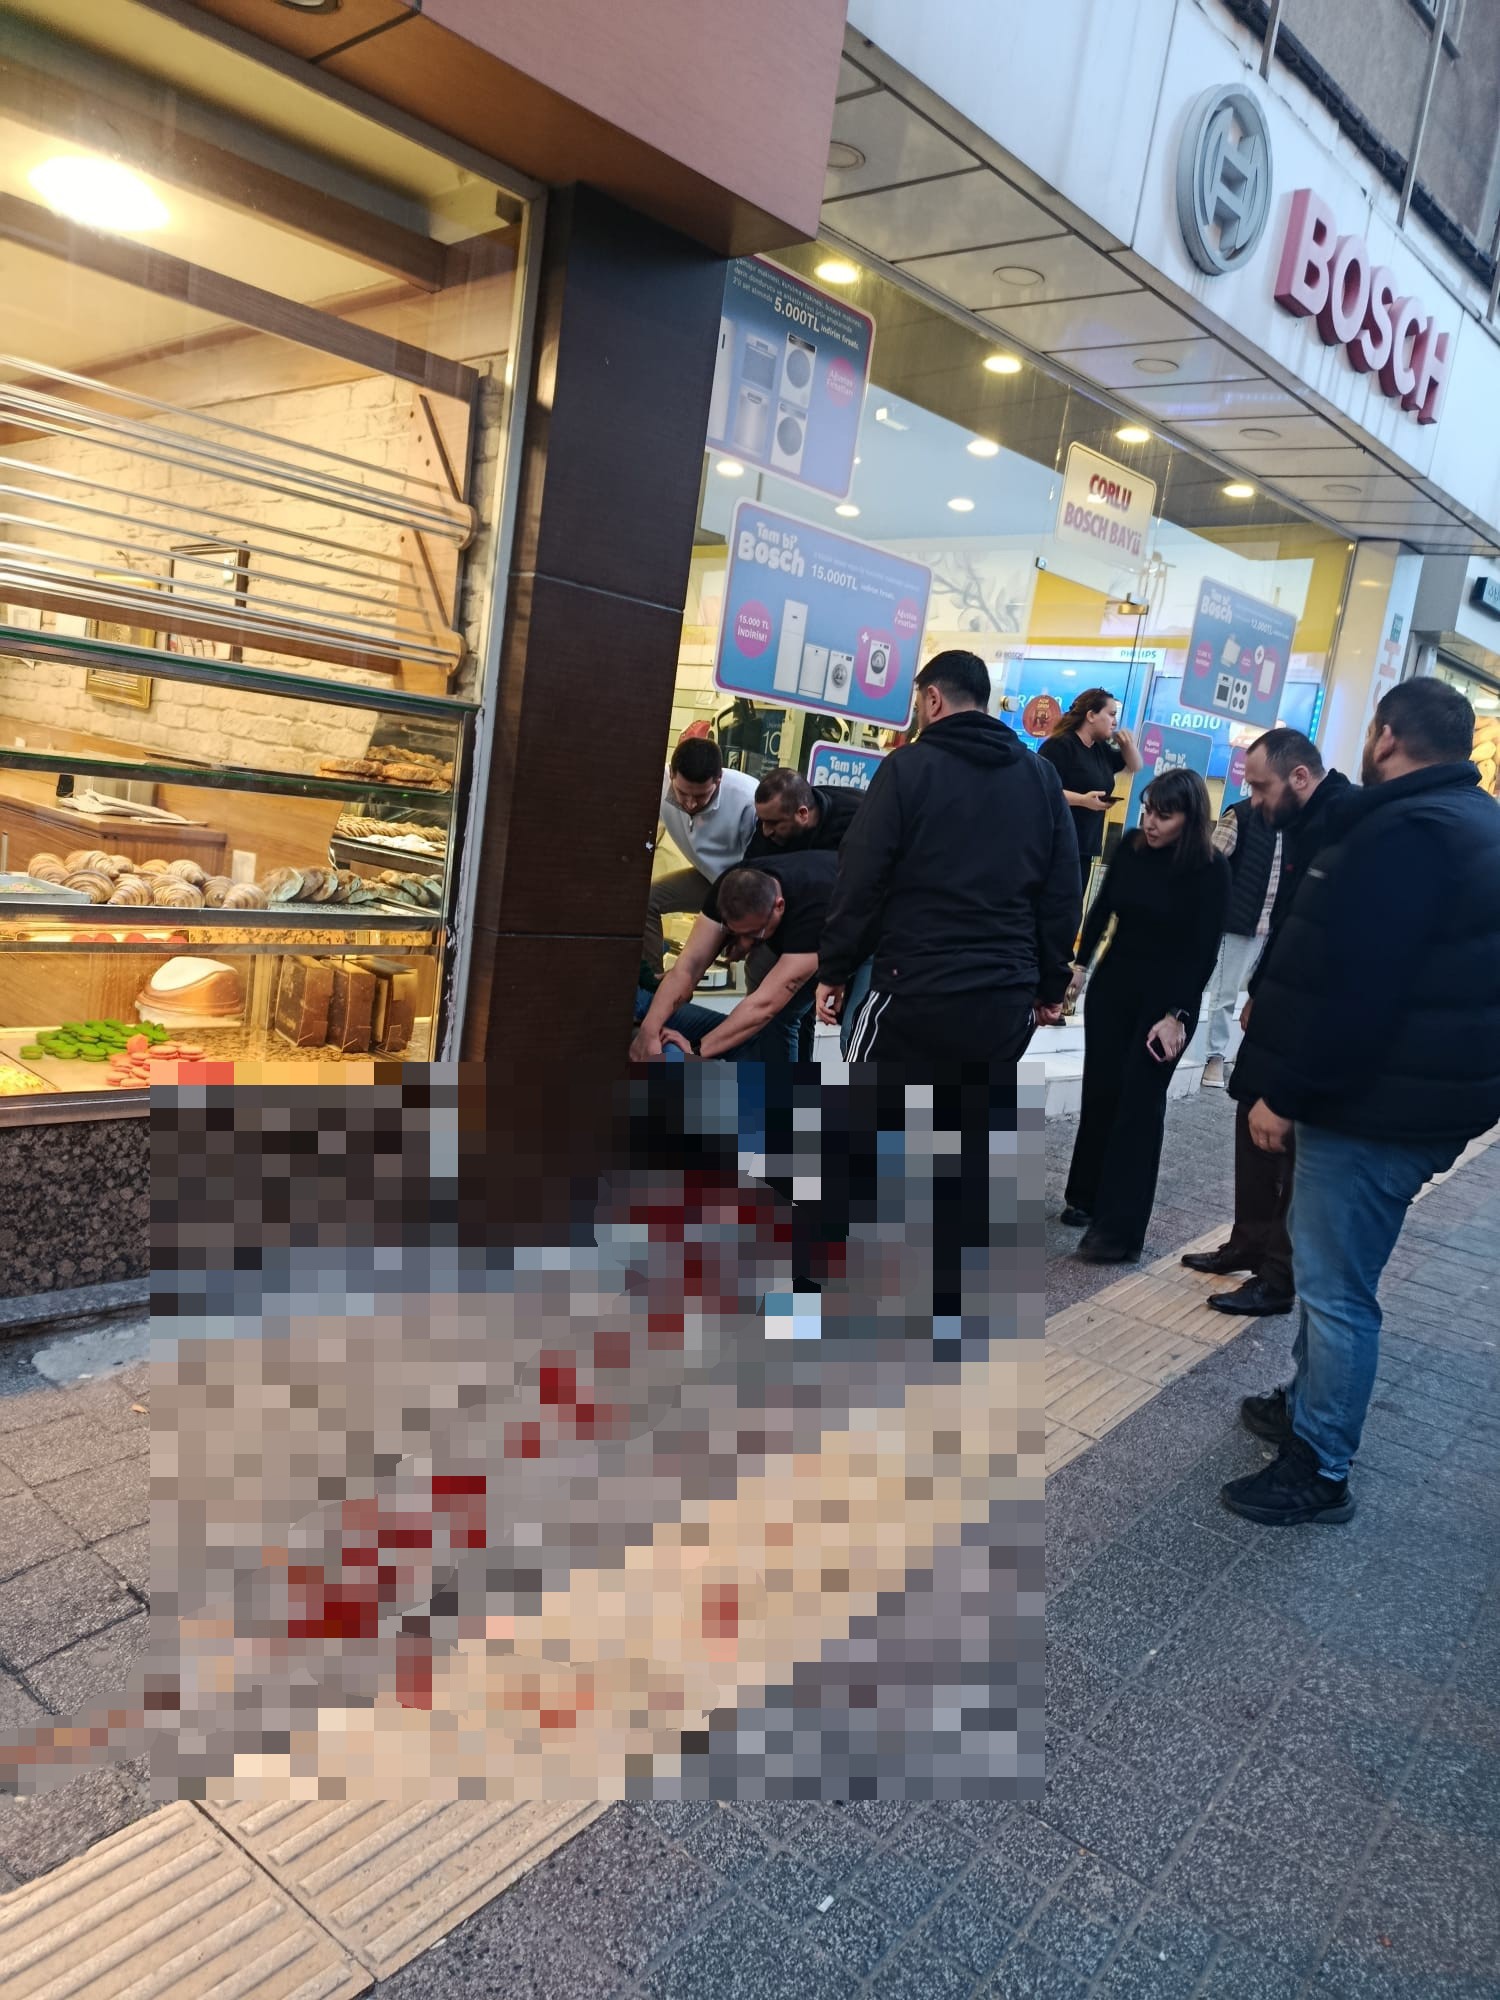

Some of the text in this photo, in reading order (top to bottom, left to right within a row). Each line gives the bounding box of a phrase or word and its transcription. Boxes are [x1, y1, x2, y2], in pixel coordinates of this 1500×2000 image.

[774, 296, 820, 333] 5.000TL
[1276, 188, 1449, 424] BOSCH
[756, 521, 780, 545] Tam
[1064, 502, 1109, 541] BOSCH
[738, 530, 804, 578] Bosch
[811, 563, 858, 591] 15.000TL
[739, 614, 769, 630] 15.000 TL
[1200, 594, 1233, 624] Bosch
[830, 756, 849, 773] Tam
